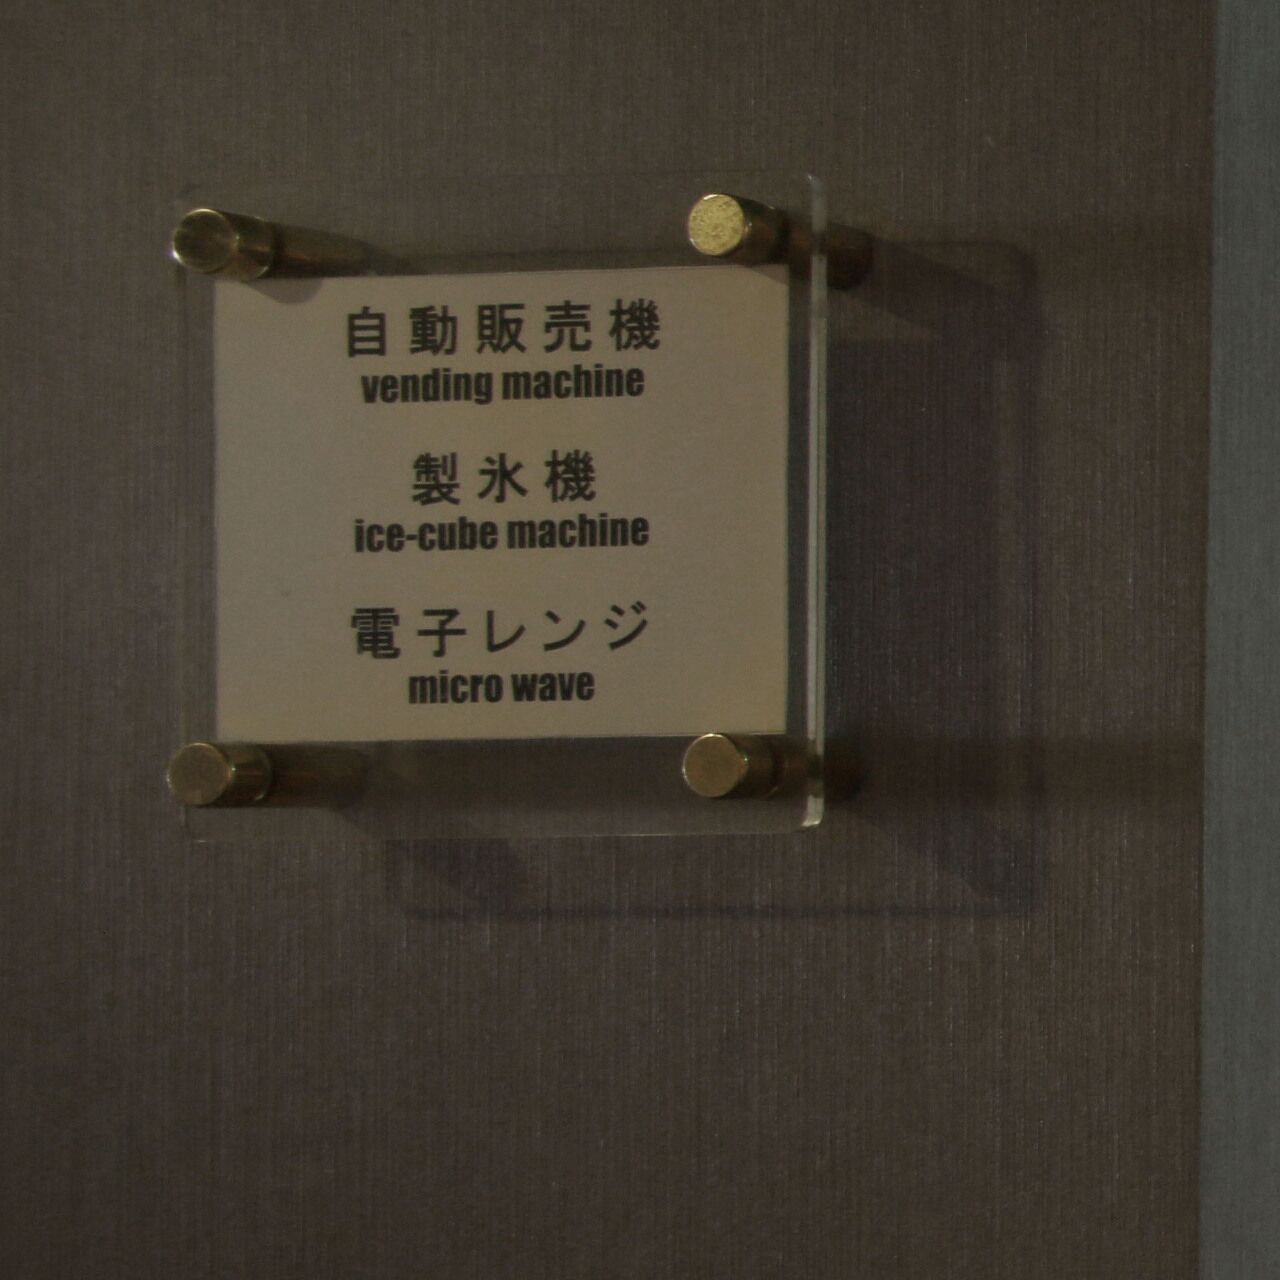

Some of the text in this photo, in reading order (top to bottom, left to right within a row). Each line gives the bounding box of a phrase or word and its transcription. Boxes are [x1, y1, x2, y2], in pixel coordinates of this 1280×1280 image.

[347, 298, 661, 357] 自動販売機
[361, 363, 646, 405] vending machine
[412, 449, 596, 506] 製氷機
[355, 513, 650, 552] ice-cube machine
[350, 600, 648, 660] 電子レンジ
[408, 669, 596, 705] micro wave
